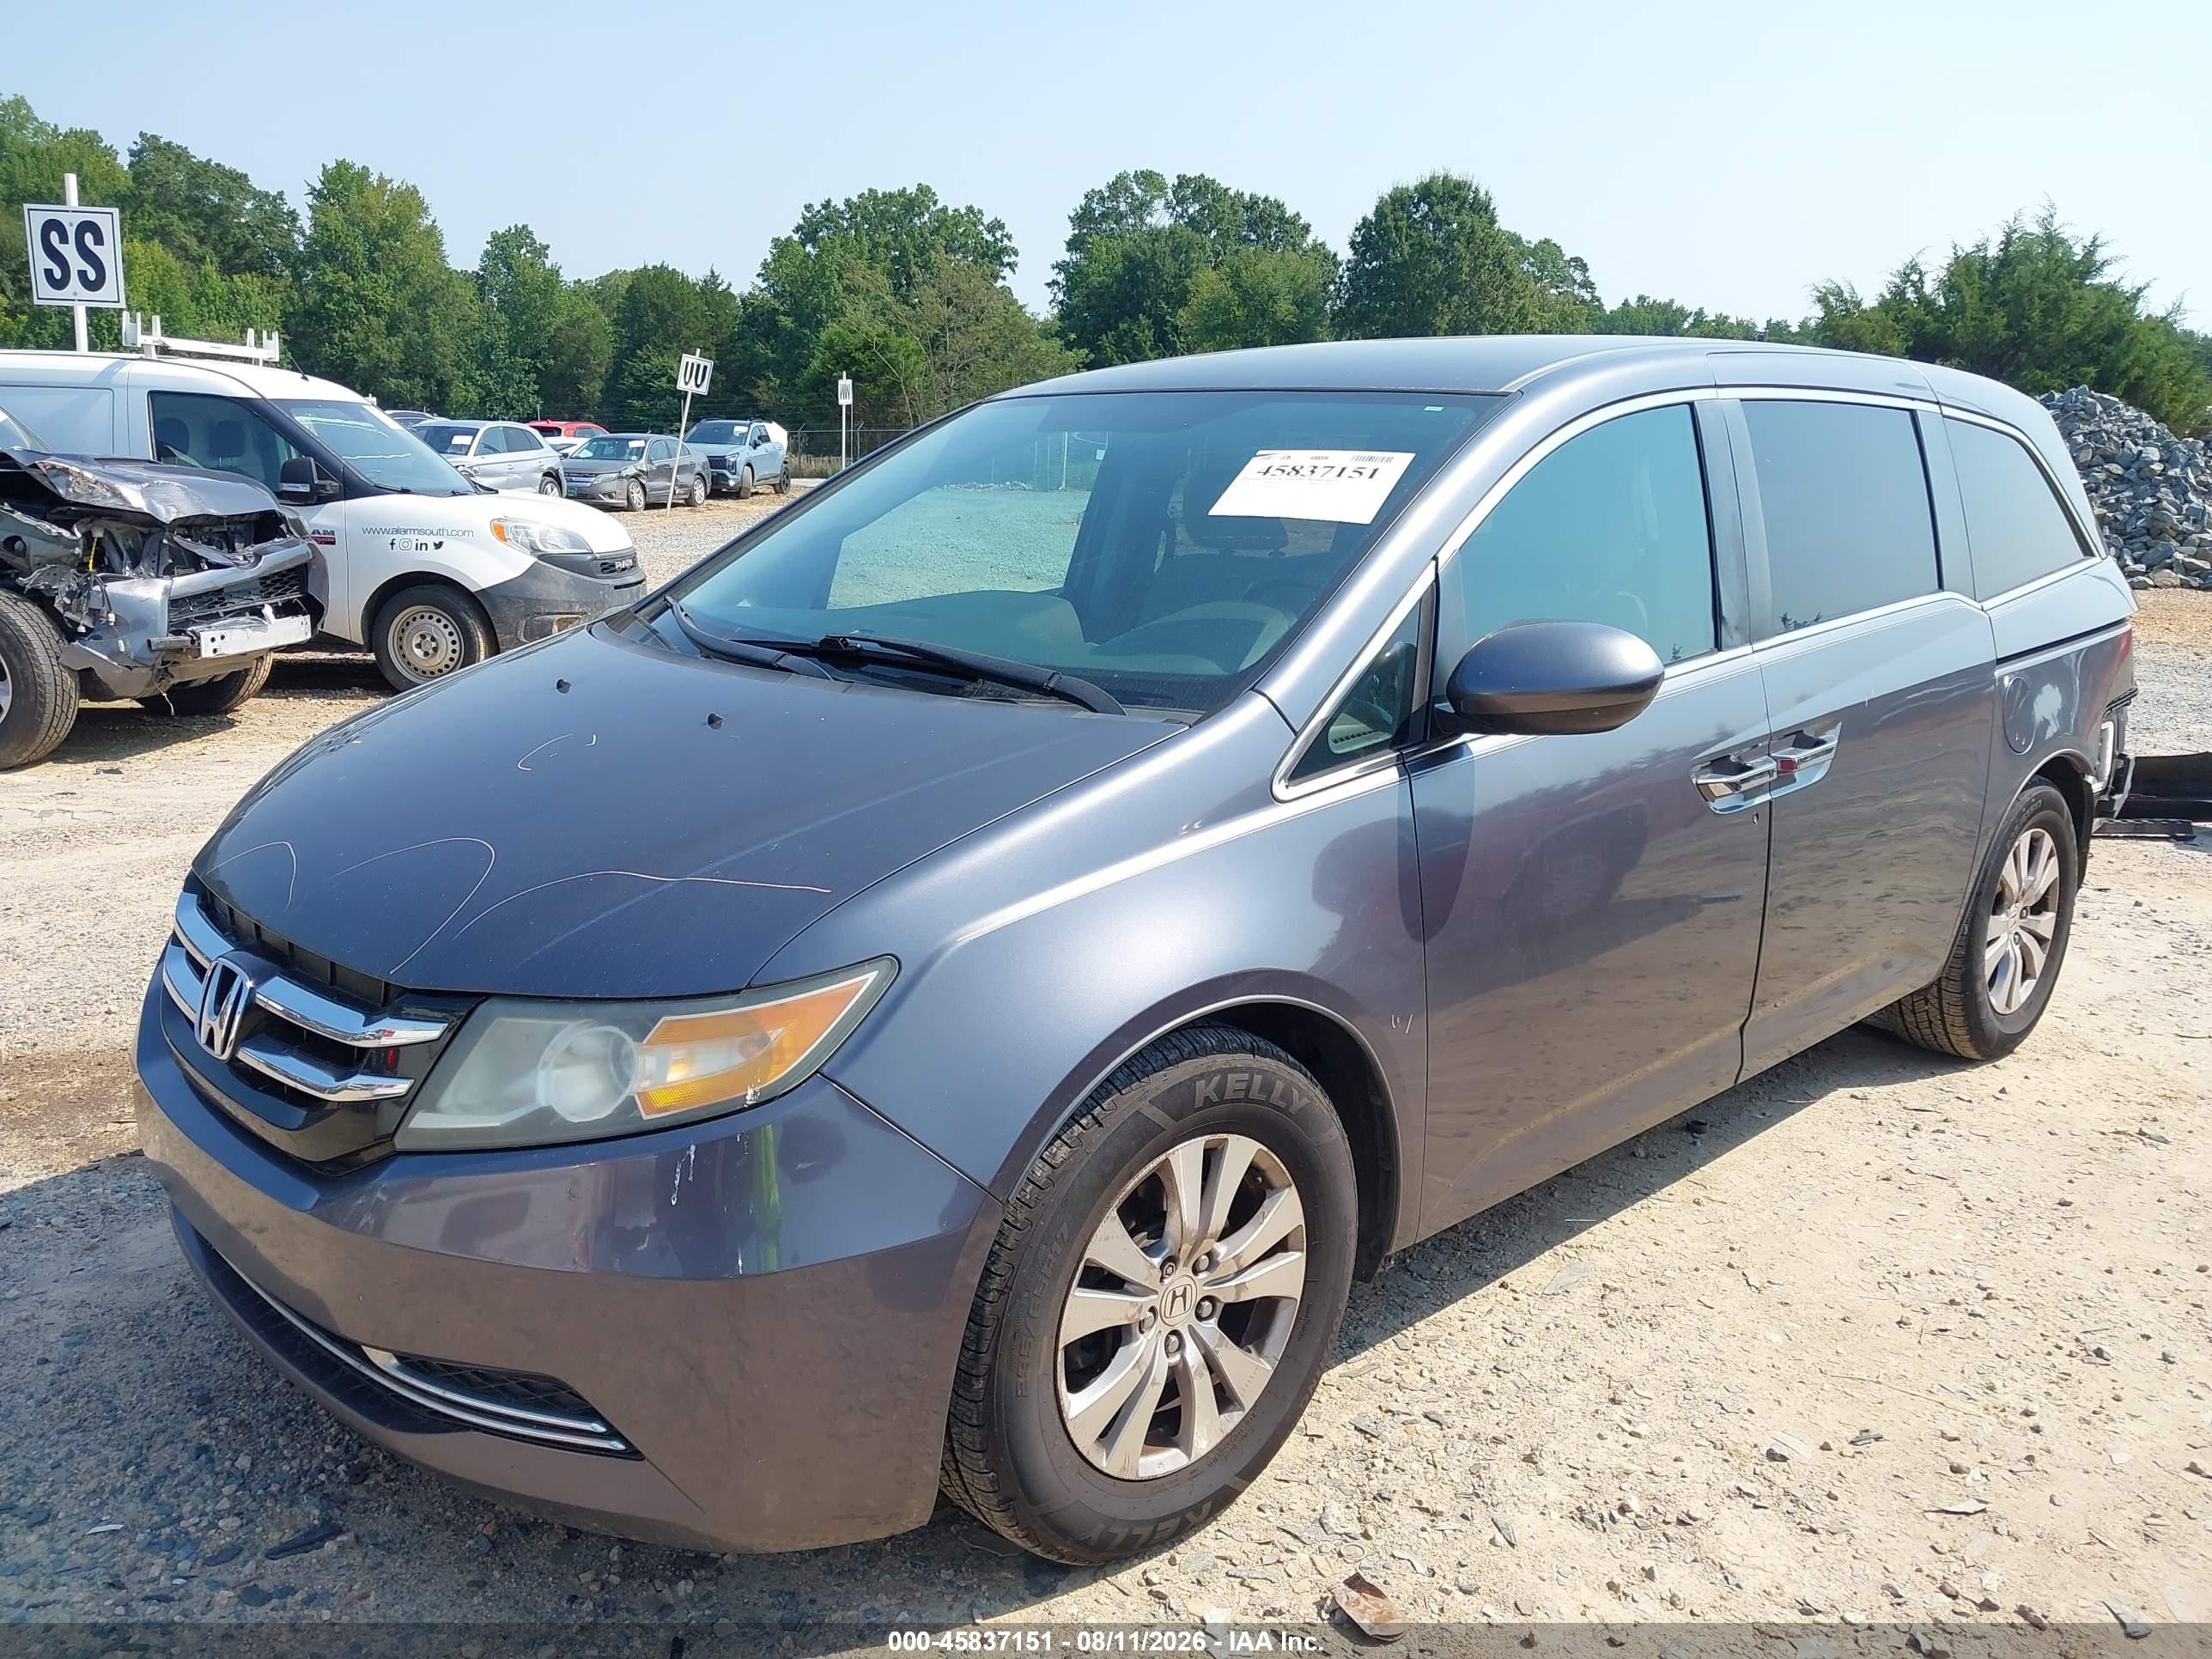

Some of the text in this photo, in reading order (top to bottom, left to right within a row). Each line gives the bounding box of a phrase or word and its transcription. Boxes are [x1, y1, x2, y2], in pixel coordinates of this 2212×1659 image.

[40, 218, 106, 292] SS
[684, 361, 708, 388] UU
[1257, 465, 1380, 480] 45837151
[362, 526, 474, 538] www.alarmsouth.com
[1194, 1073, 1309, 1115] KELLY
